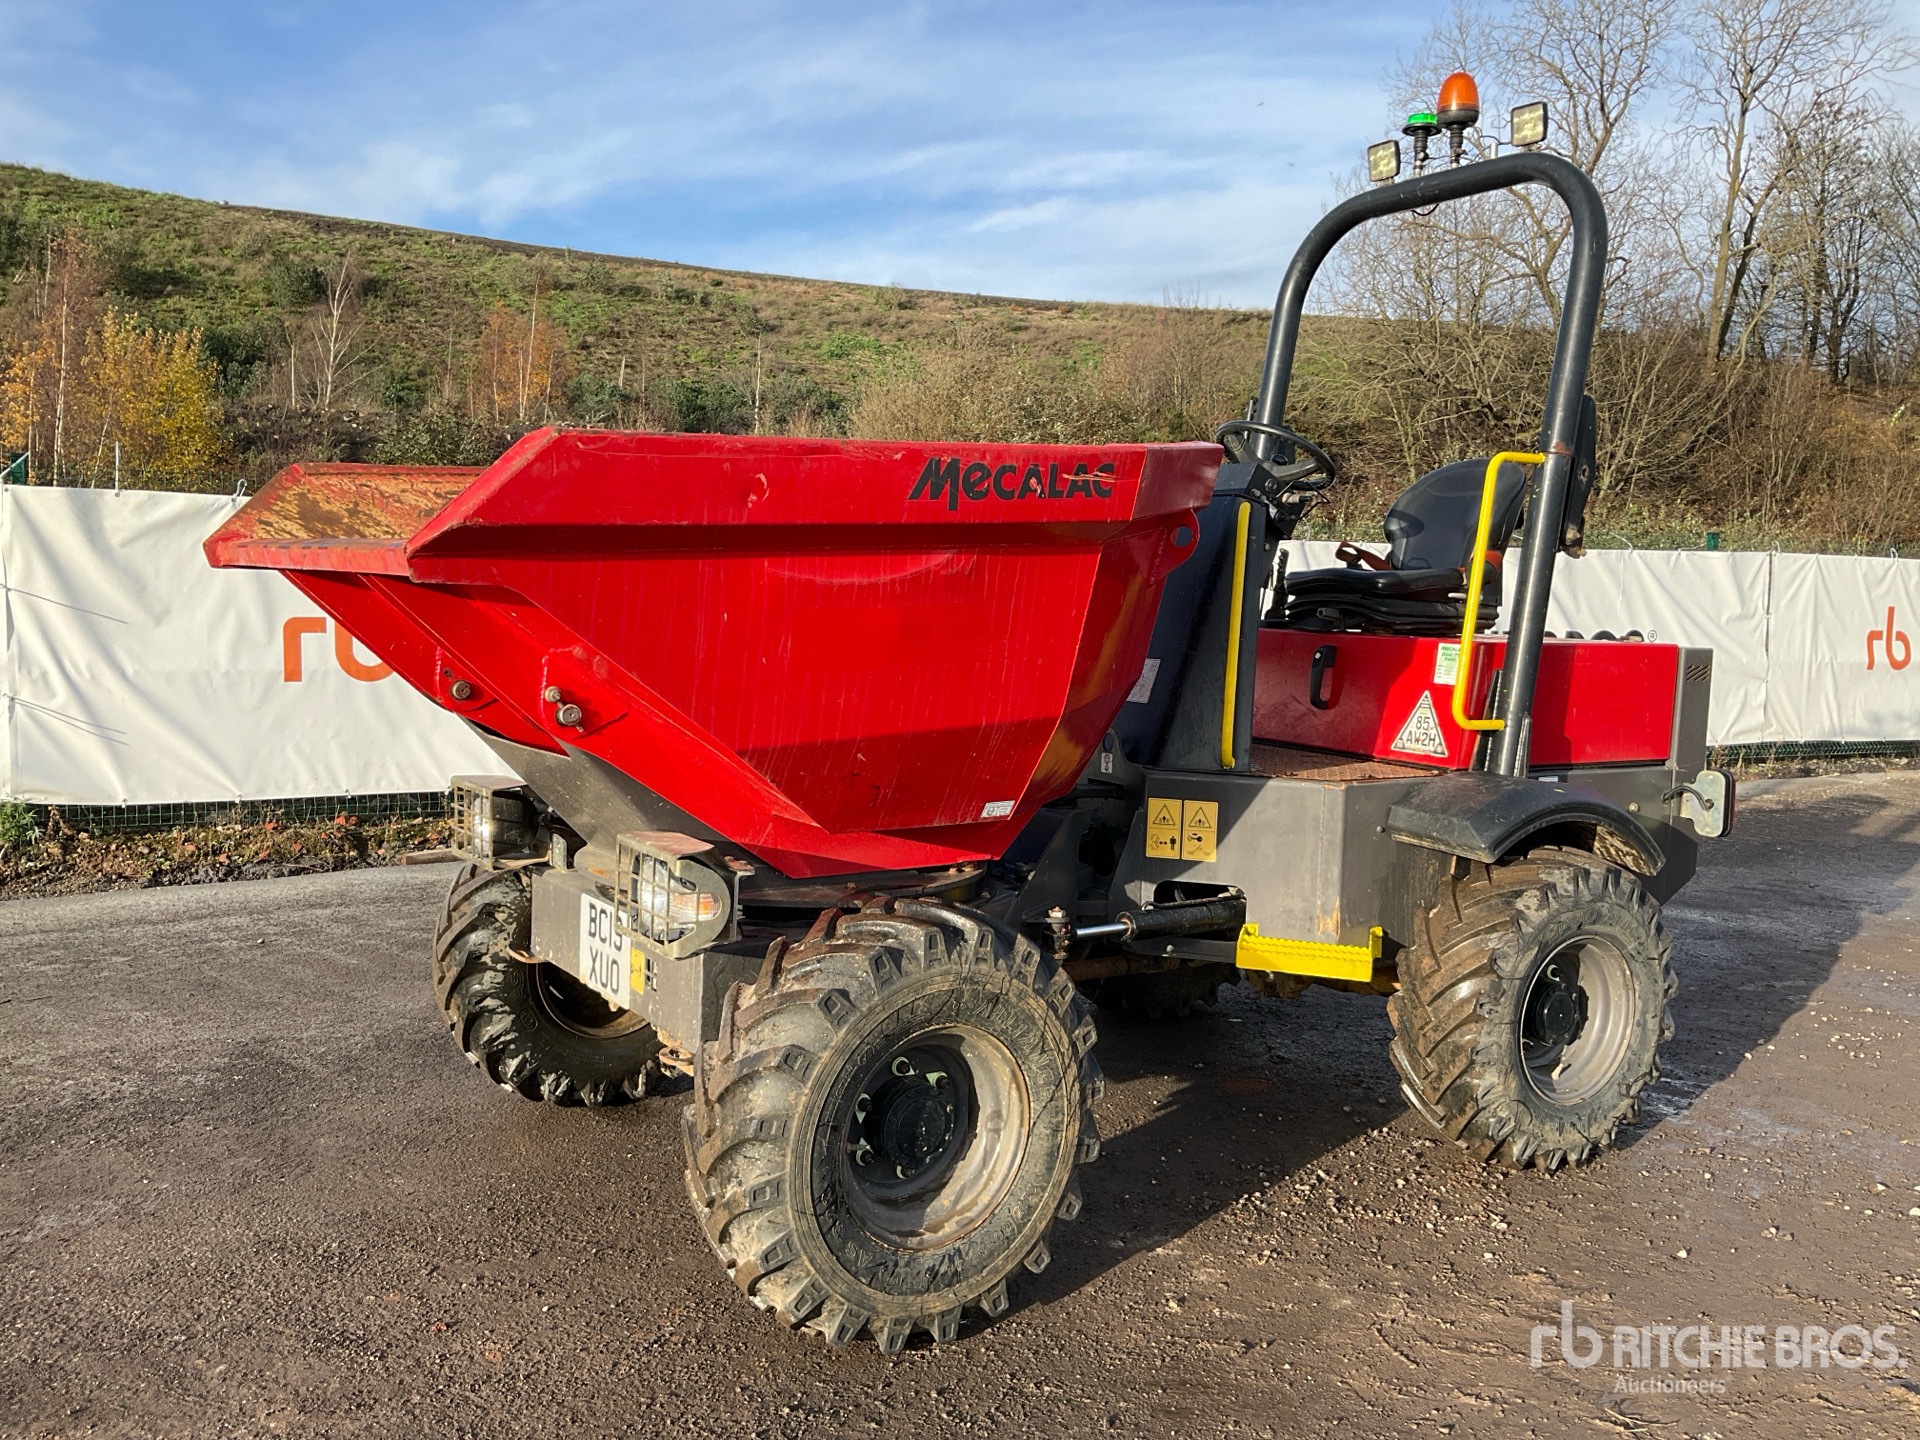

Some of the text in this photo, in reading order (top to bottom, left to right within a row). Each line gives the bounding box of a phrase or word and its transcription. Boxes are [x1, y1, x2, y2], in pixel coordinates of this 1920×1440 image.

[1866, 606, 1911, 670] rb
[1415, 716, 1431, 731] 85
[589, 946, 620, 995] XUO
